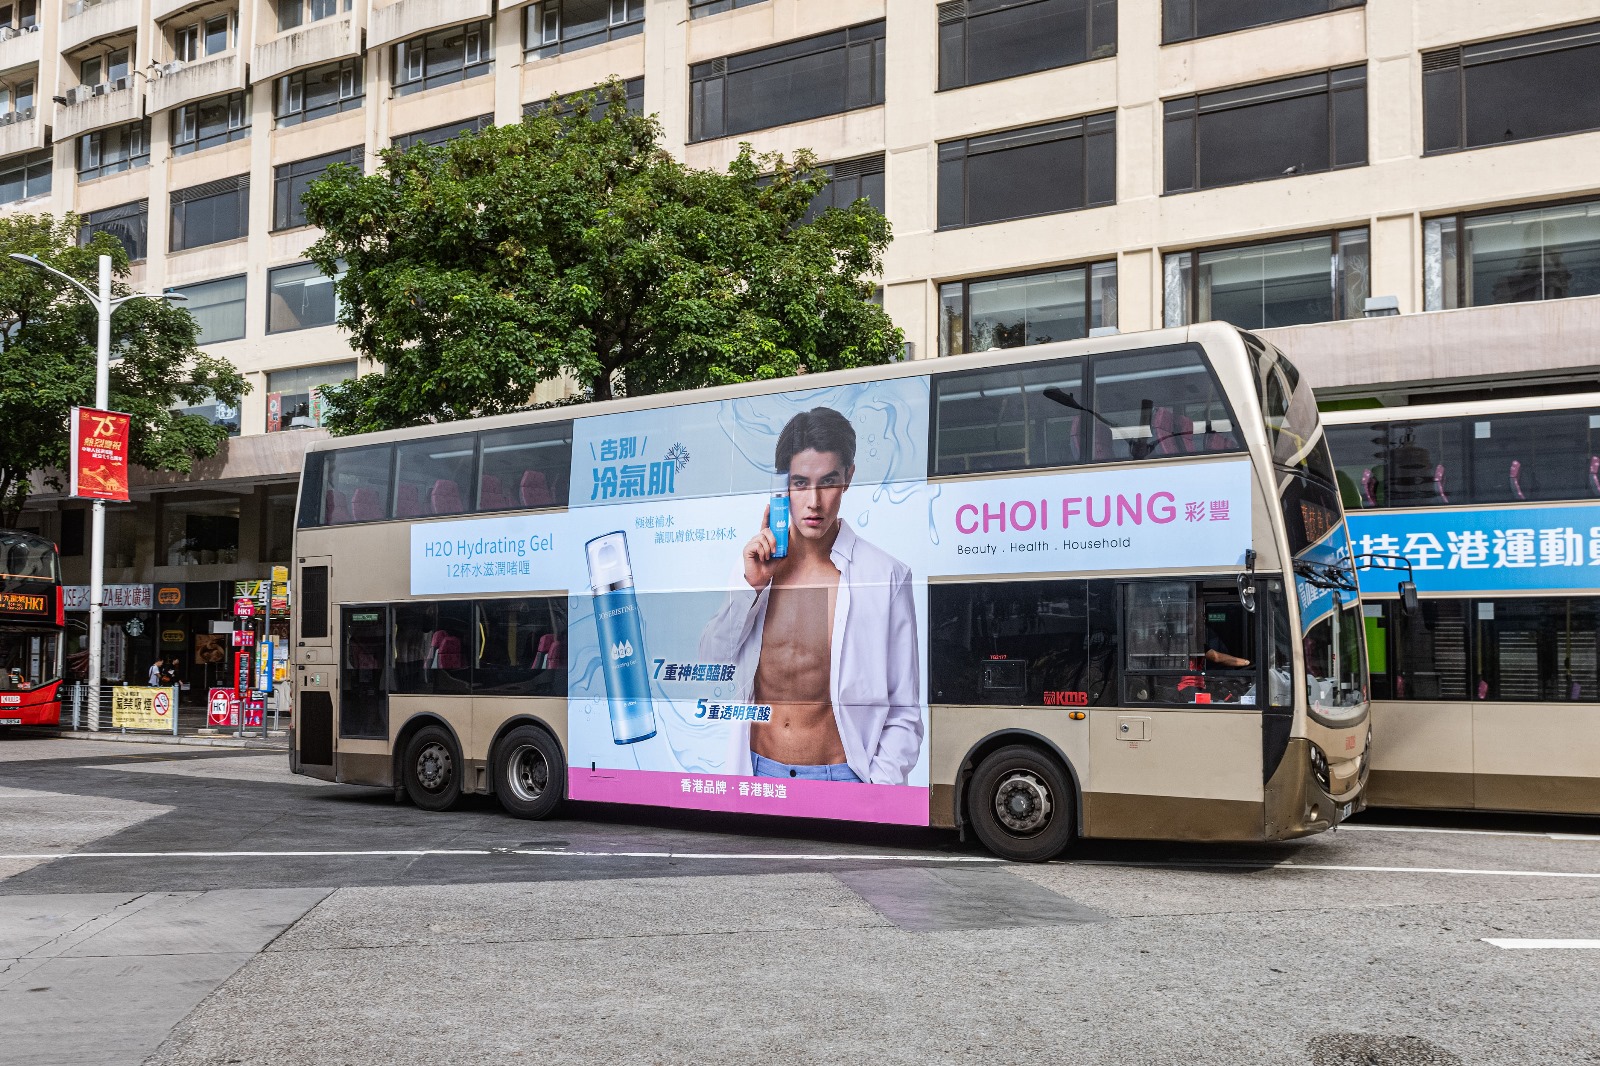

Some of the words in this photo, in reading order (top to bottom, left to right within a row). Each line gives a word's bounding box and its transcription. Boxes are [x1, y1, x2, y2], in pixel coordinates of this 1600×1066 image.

[91, 416, 117, 437] 75
[600, 436, 637, 462] 告別
[591, 460, 675, 500] 冷氣肌
[635, 514, 675, 529] 極速補水
[955, 498, 1048, 534] CHOI
[1062, 491, 1177, 529] FUNG
[1184, 500, 1231, 523] 彩豐
[425, 541, 453, 557] H2O
[457, 537, 526, 559] Hydrating
[529, 533, 553, 551] Gel
[957, 543, 997, 555] Beauty
[1010, 541, 1049, 553] Health
[1063, 537, 1131, 550] Household
[1351, 527, 1600, 570] 持全港運動
[446, 560, 531, 578] 12杯水滋潤啫喱
[25, 597, 44, 610] HK1
[114, 587, 152, 607] 星光廣場
[237, 607, 251, 615] HK1
[1, 695, 21, 703] KMB
[213, 702, 226, 712] HK1
[1056, 691, 1088, 706] KMB
[694, 698, 771, 721] 5重透明質酸
